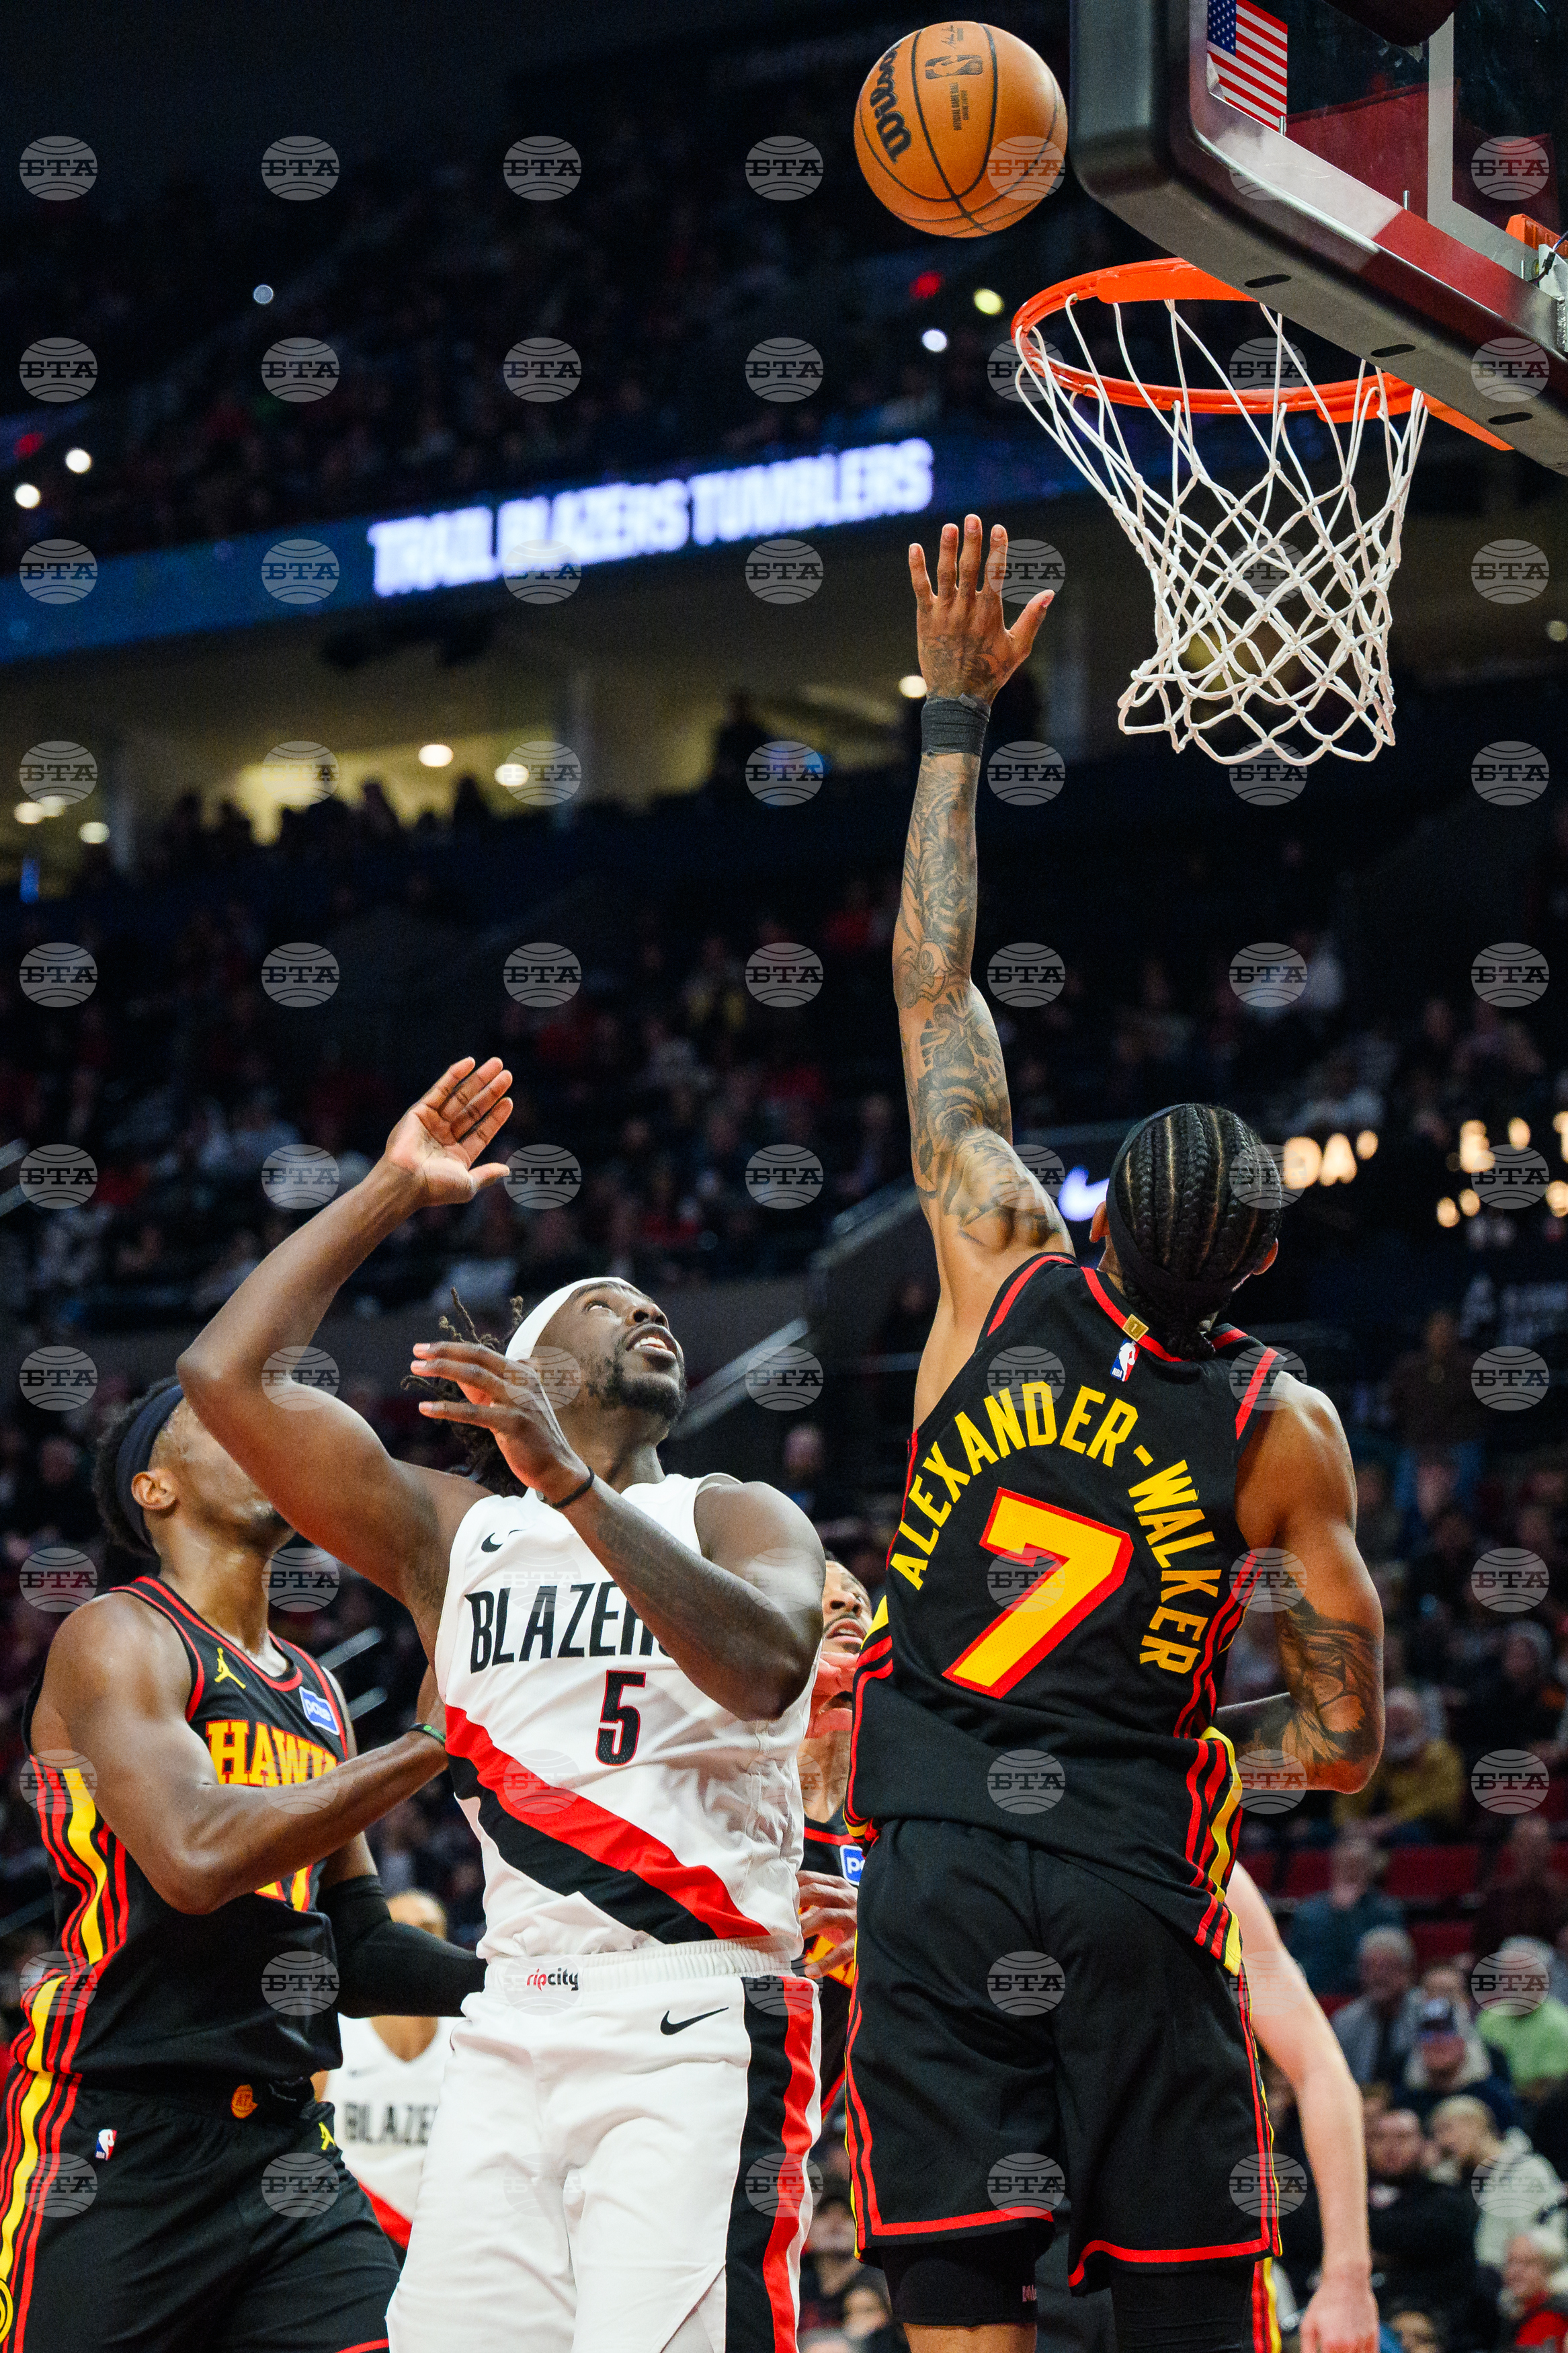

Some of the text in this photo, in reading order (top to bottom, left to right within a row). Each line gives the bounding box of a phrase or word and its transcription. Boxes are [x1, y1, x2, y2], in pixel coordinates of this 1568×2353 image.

[870, 44, 912, 164] Wilso
[368, 438, 934, 597] TRAIL BLAZERS TUMBLERS
[890, 1381, 1222, 1674] ALEXANDER-WALKER
[942, 1486, 1134, 1699] 7
[206, 1719, 341, 1788] HAWK
[595, 1669, 647, 1766] 5
[526, 1967, 579, 1991] ripcity
